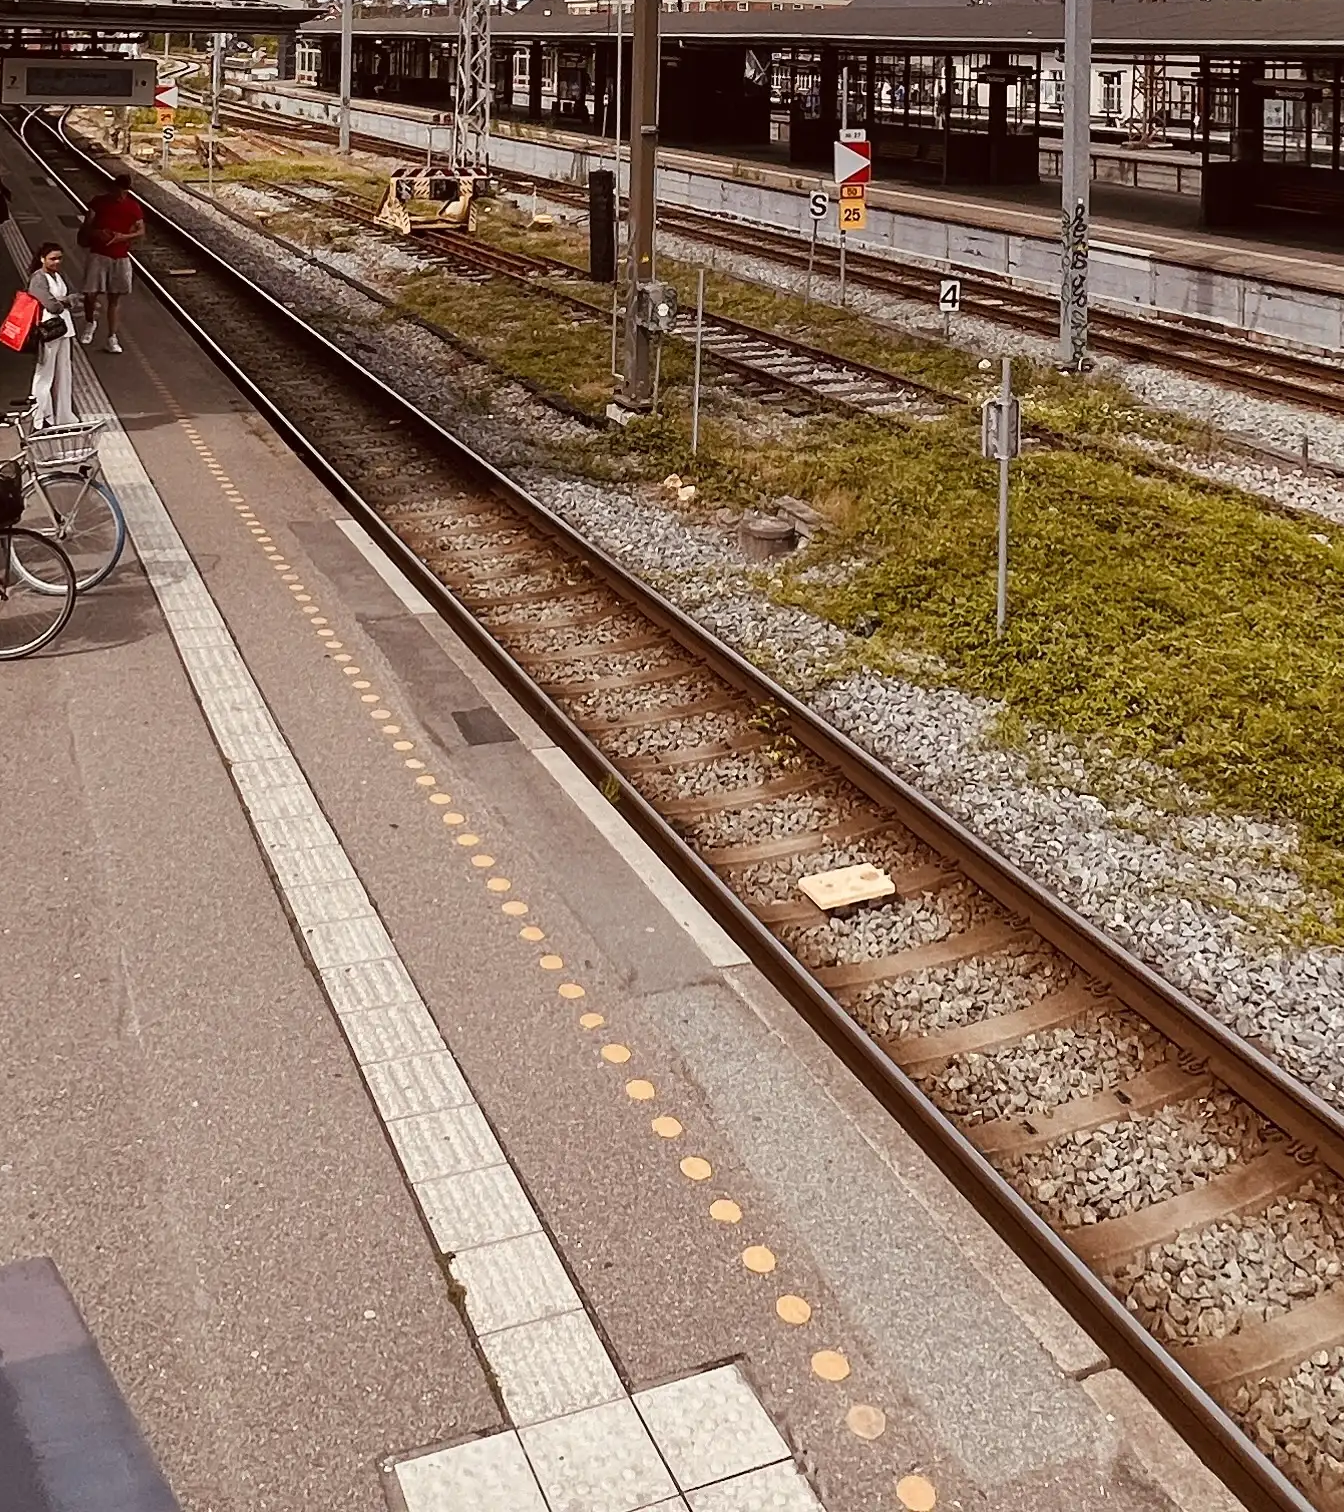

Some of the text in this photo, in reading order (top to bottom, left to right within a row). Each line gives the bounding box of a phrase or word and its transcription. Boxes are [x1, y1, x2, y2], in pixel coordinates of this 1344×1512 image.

[9, 76, 17, 86] 7
[162, 127, 174, 140] S
[810, 194, 827, 217] S
[844, 208, 861, 222] 25
[940, 284, 960, 308] 4
